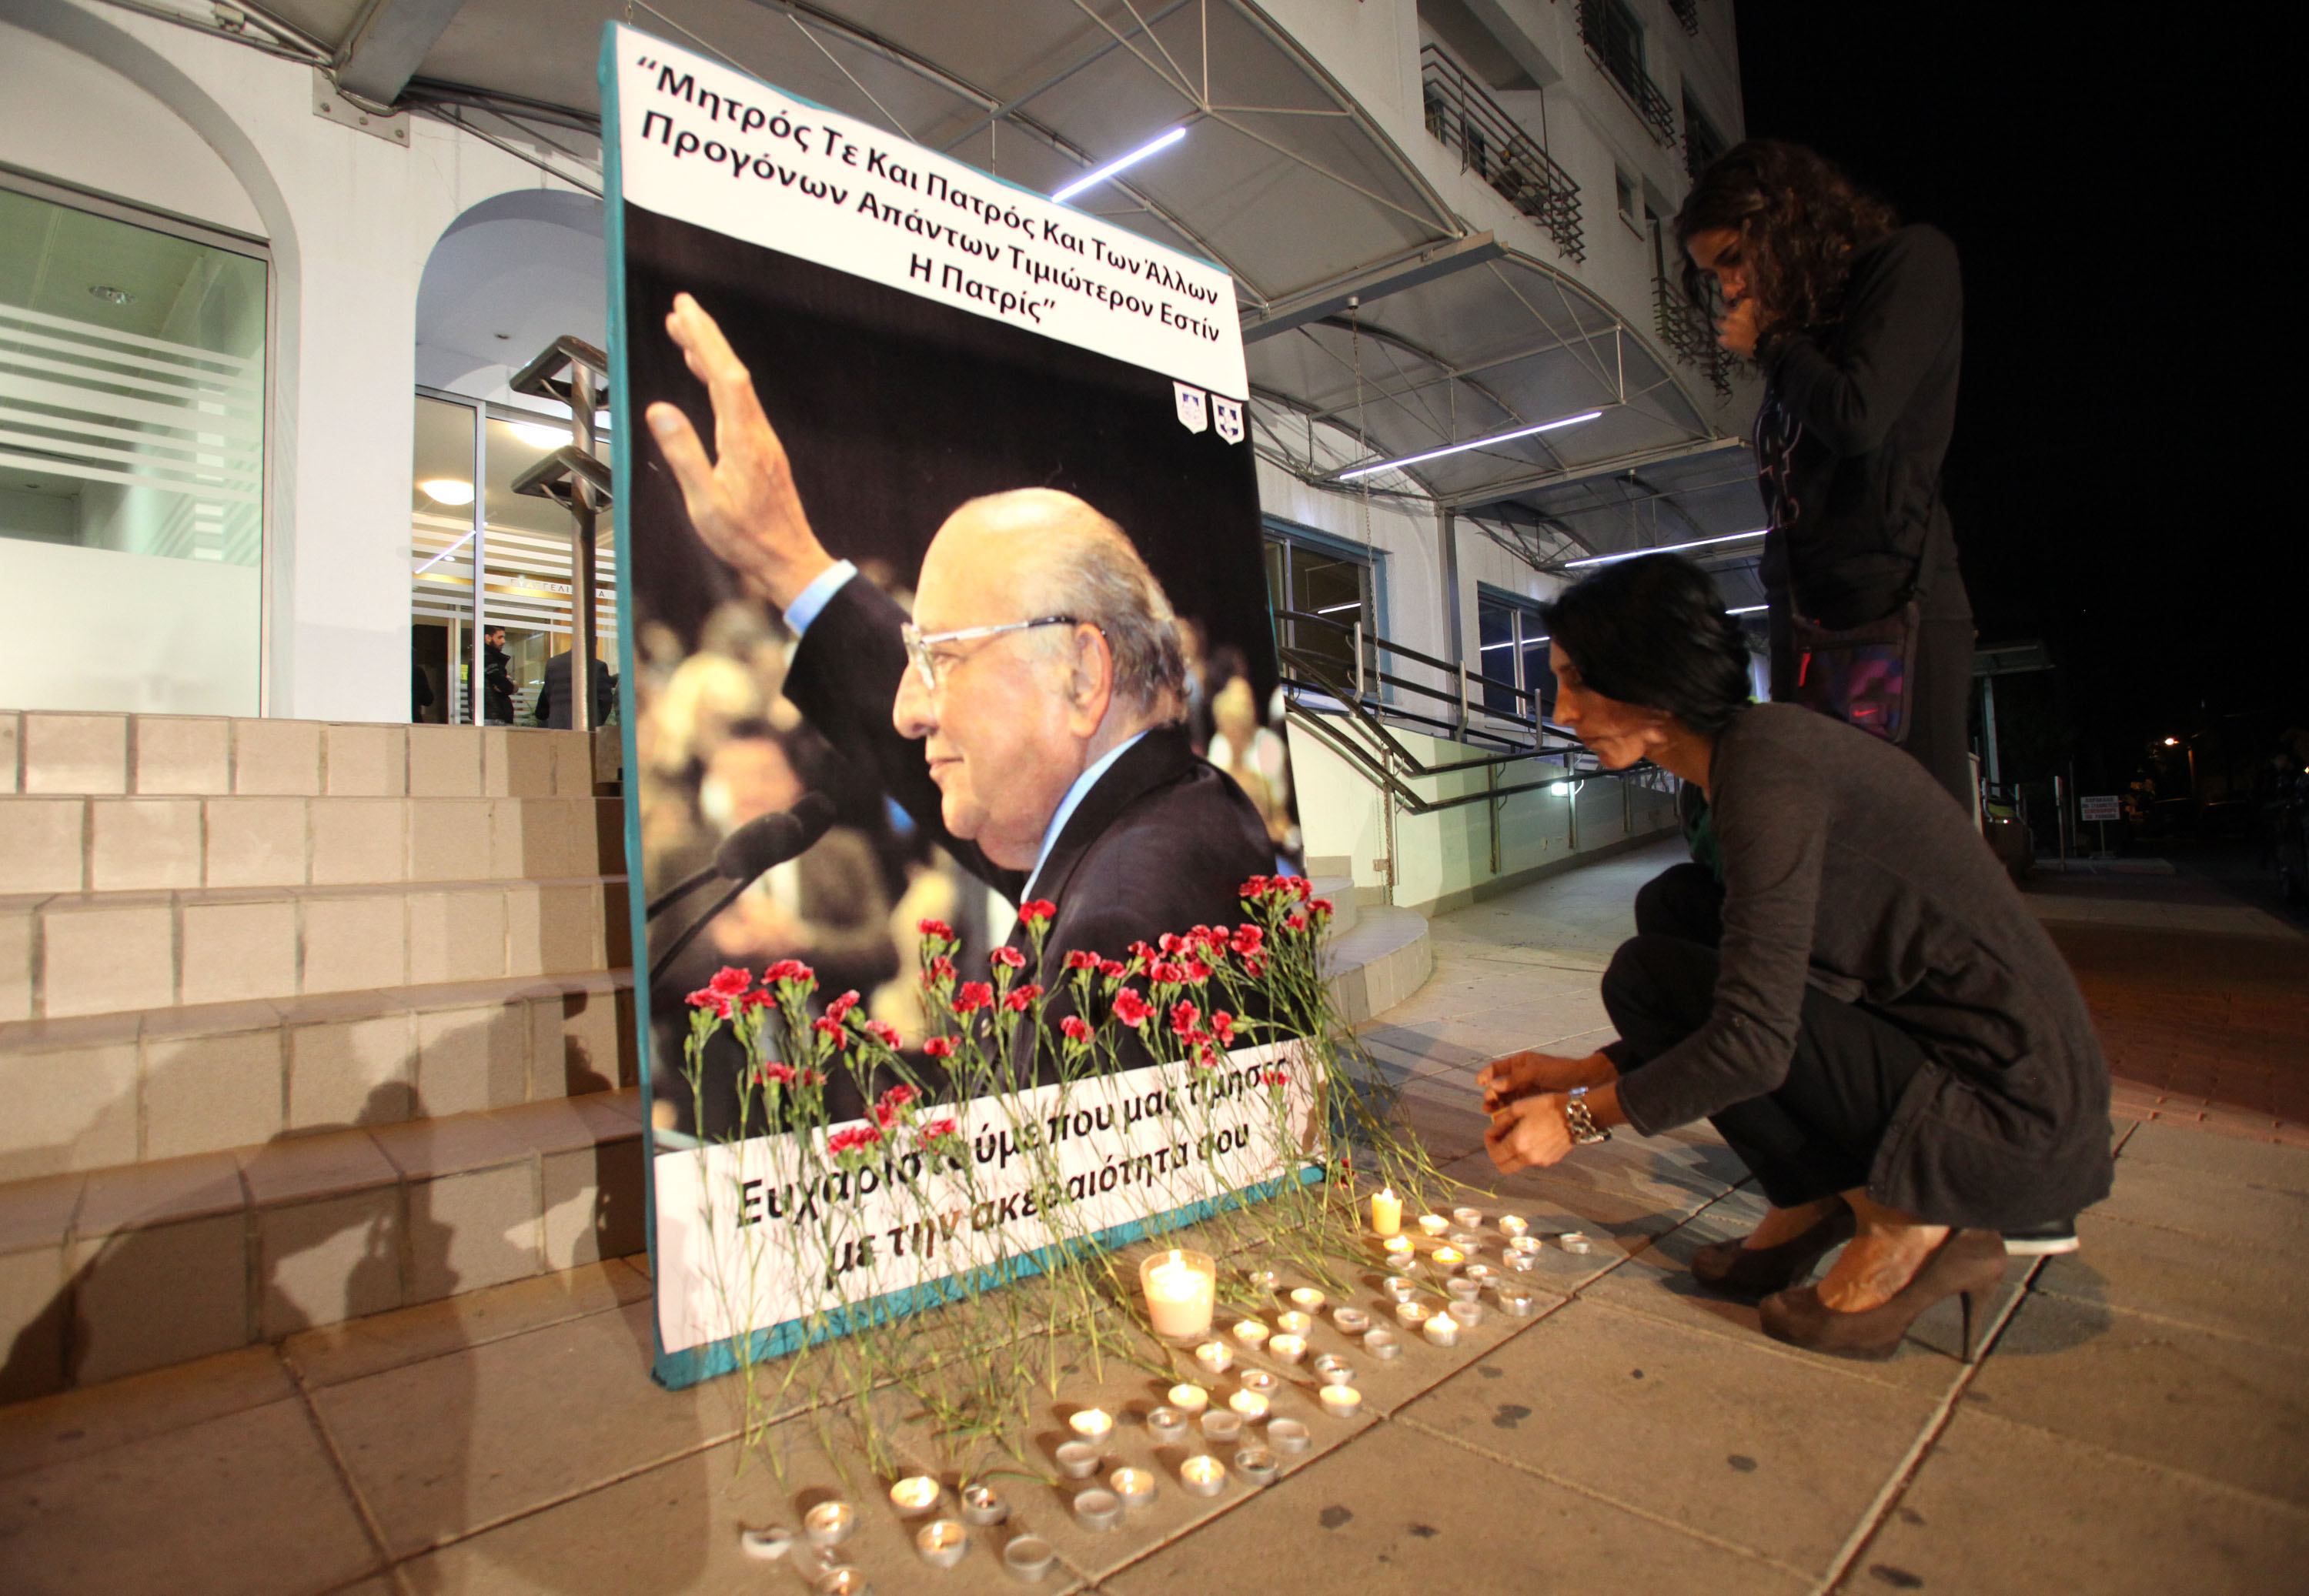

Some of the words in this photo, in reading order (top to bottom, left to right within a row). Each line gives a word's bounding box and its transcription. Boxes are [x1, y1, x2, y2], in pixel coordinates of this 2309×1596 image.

[636, 55, 811, 153] “Μητρός
[823, 126, 858, 166] Τε
[867, 148, 917, 190] Και
[927, 172, 1035, 240] Πατρός
[1044, 219, 1084, 255] Και
[1091, 238, 1141, 275] Των
[1144, 259, 1218, 305] Άλλων
[642, 110, 848, 205] Προγόνων
[857, 192, 1000, 262] Απάντων
[1007, 245, 1154, 317] Τιμιώτερον
[1161, 302, 1219, 342] Εστίν
[910, 253, 932, 282] Η
[1048, 1104, 1114, 1144] που
